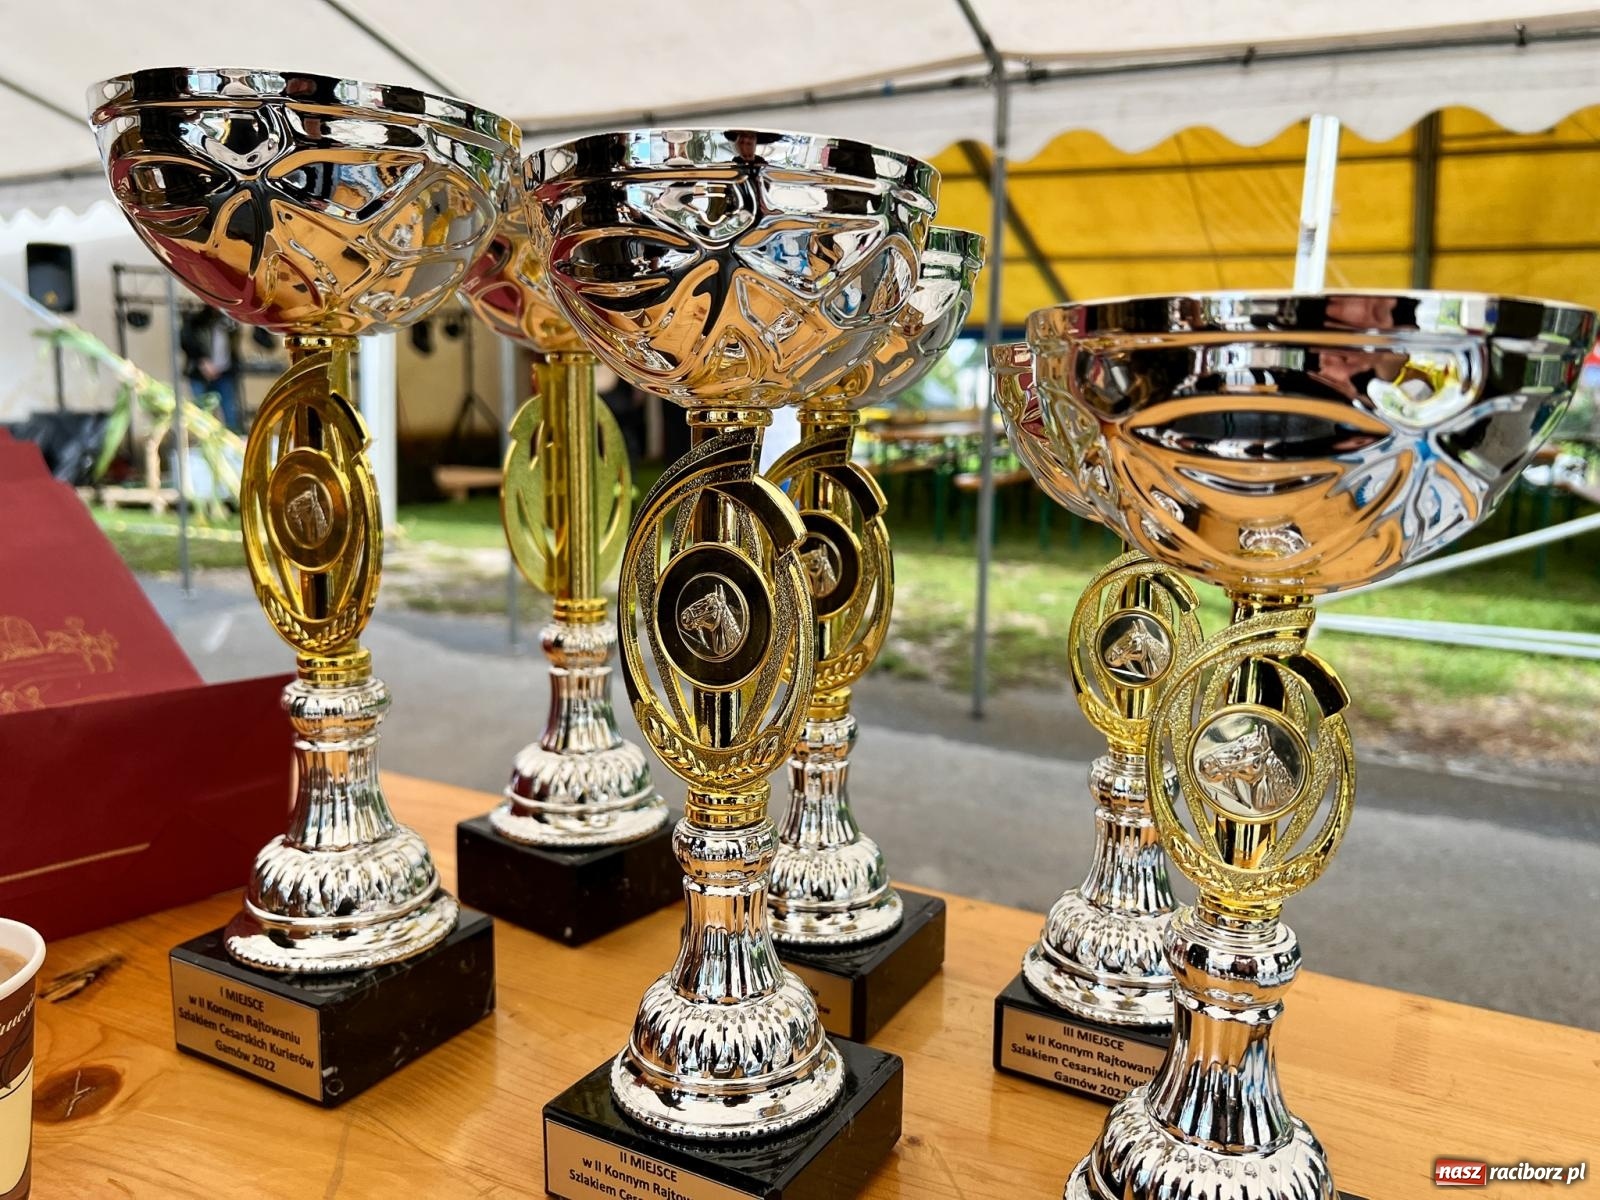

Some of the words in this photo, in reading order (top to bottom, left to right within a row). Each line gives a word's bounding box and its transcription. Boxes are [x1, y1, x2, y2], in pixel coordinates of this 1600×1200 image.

[226, 988, 265, 1013] MIEJSCE
[188, 995, 197, 1005] w
[198, 996, 205, 1008] II
[206, 1001, 245, 1024] Konnym
[246, 1015, 301, 1046] Rajtowaniu
[178, 1007, 218, 1031] Szlakiem
[219, 1023, 268, 1052] Cesarskich
[270, 1043, 314, 1070] Kurierów
[1025, 1032, 1036, 1043] w
[1038, 1034, 1045, 1045] II
[1048, 1037, 1094, 1060] Konnym
[1063, 1026, 1074, 1038] III
[1077, 1029, 1125, 1052] MIEJSCE
[215, 1039, 251, 1063] Gamów
[252, 1054, 276, 1073] 2022
[1010, 1043, 1059, 1065] Szlakiem
[1061, 1057, 1120, 1083] Cesarskich
[1054, 1070, 1098, 1092] Gamów
[569, 1169, 617, 1197] Szlakiem
[582, 1157, 592, 1169] w
[594, 1160, 602, 1172] II
[604, 1164, 650, 1191] Konnym
[619, 1151, 627, 1164] II
[630, 1155, 678, 1183] MIEJSCE
